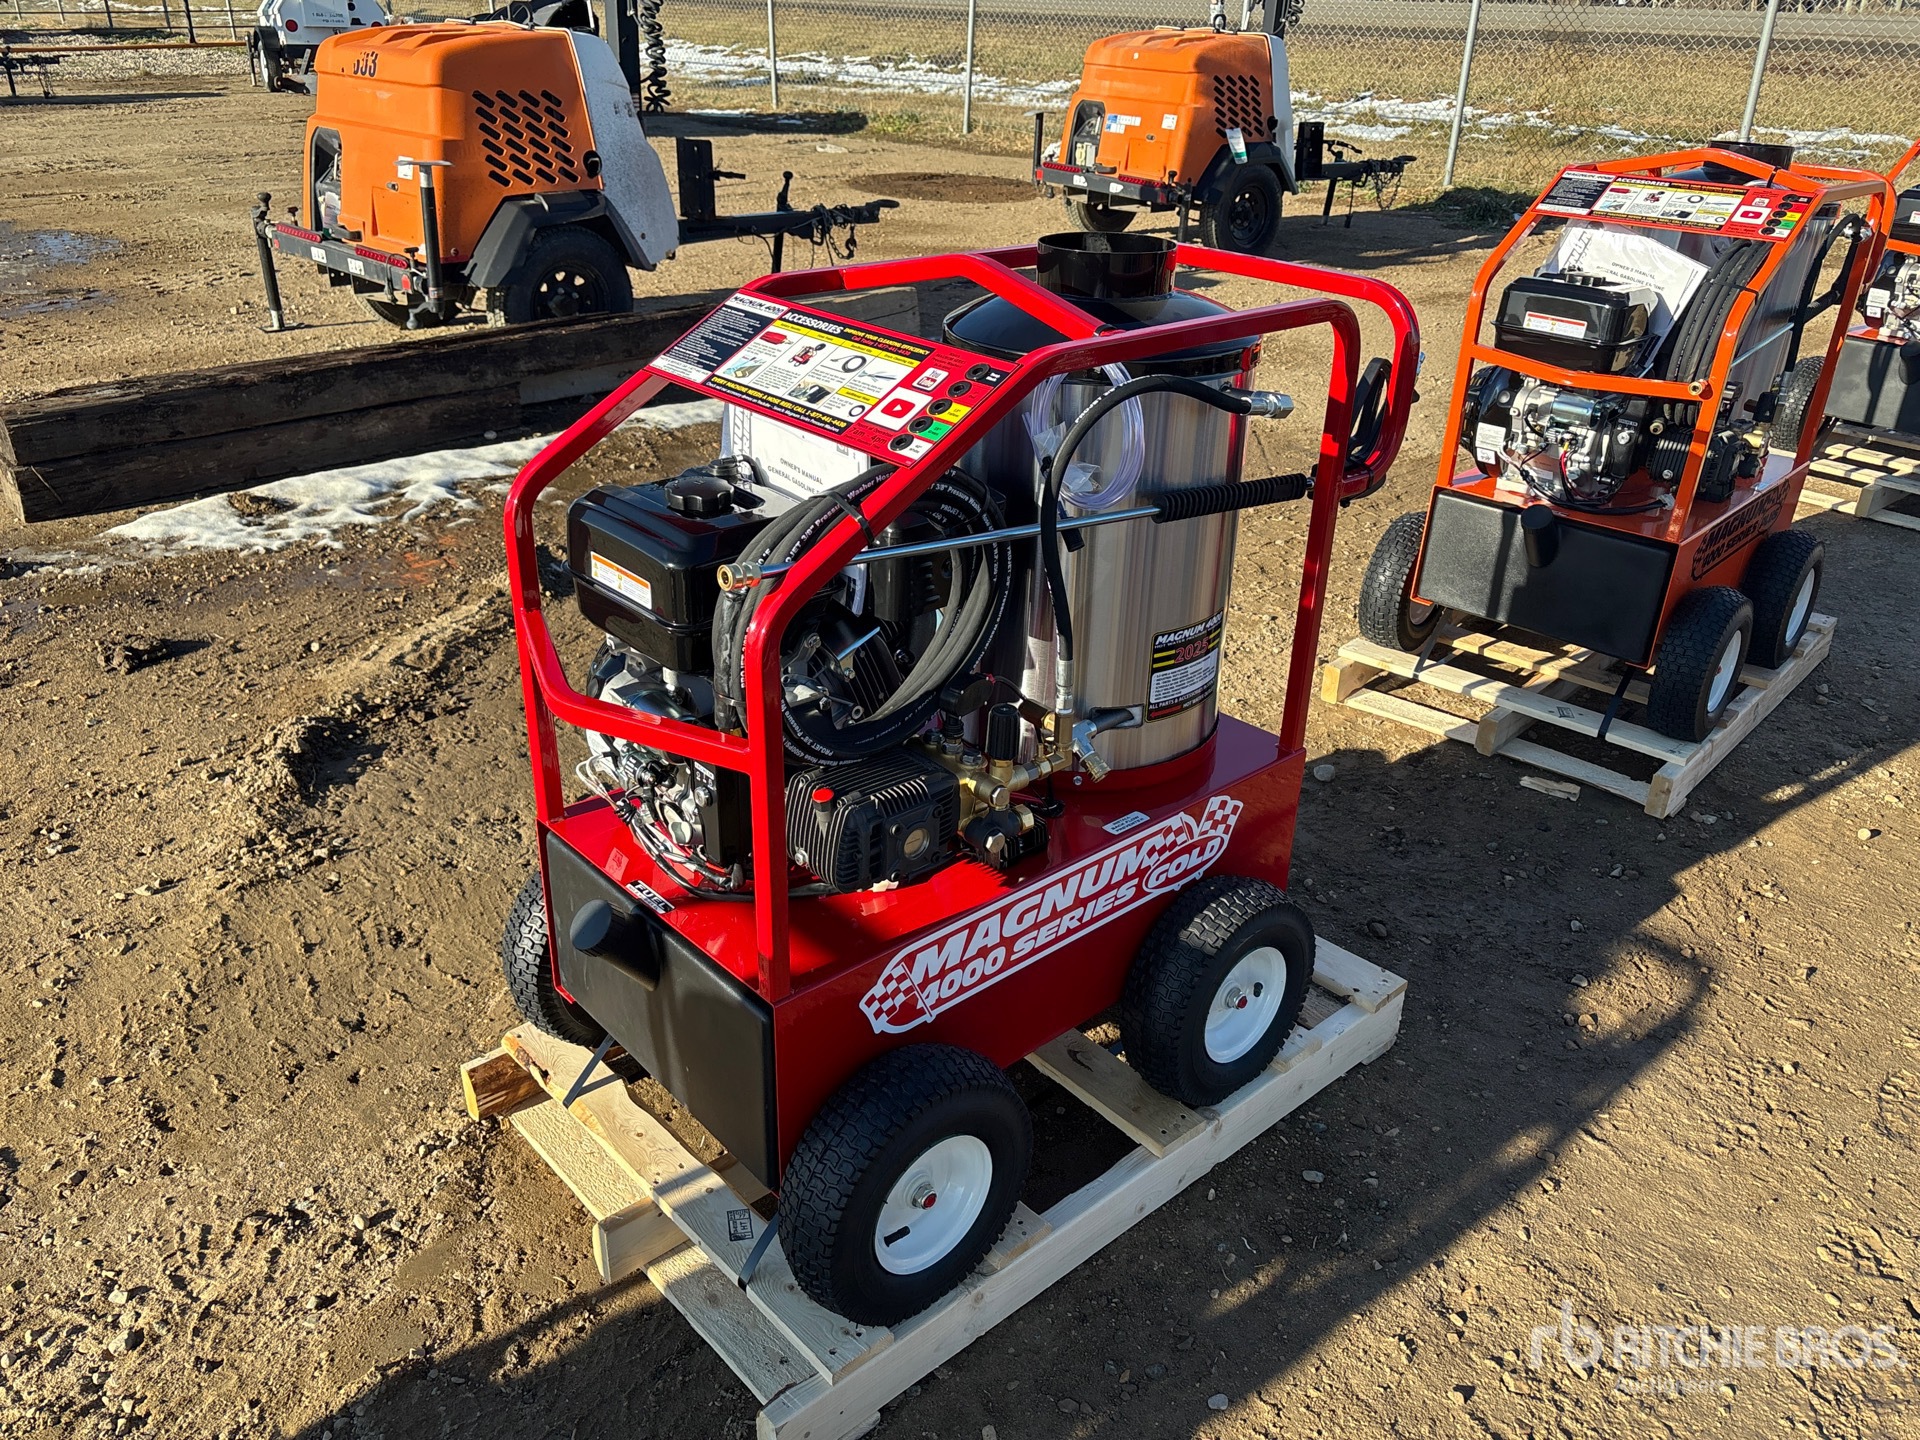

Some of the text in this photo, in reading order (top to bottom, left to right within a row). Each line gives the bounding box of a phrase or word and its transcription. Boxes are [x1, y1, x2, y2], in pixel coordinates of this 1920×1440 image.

[1616, 177, 1670, 186] ACCESSORIES
[782, 312, 844, 334] ACCESSORIES
[878, 337, 902, 348] CLEANING
[901, 343, 930, 355] EFFICIENCY
[711, 376, 727, 385] EVERY
[726, 381, 749, 393] MACHINE
[746, 389, 765, 399] NEEDS
[766, 395, 782, 405] HOSE
[794, 405, 807, 414] CALL
[851, 427, 866, 437] 7am
[870, 435, 888, 445] 4pm
[767, 465, 816, 495] GENERAL GASOLINE
[780, 457, 824, 485] OWNER'S MANUAL
[847, 479, 875, 500] Washer
[946, 486, 969, 502] Pressure
[1706, 495, 1767, 546] MAGNUM
[1155, 622, 1205, 645] MAGNUM
[1175, 636, 1210, 663] 2025
[1149, 702, 1159, 710] ALL
[1159, 698, 1175, 708] PARTS
[785, 711, 802, 738] Pressure
[811, 742, 834, 757] PROJET
[635, 884, 667, 910] FUEL
[910, 833, 1219, 984] MAGNUM GOLD
[917, 876, 1139, 1010] 4000 SERIES
